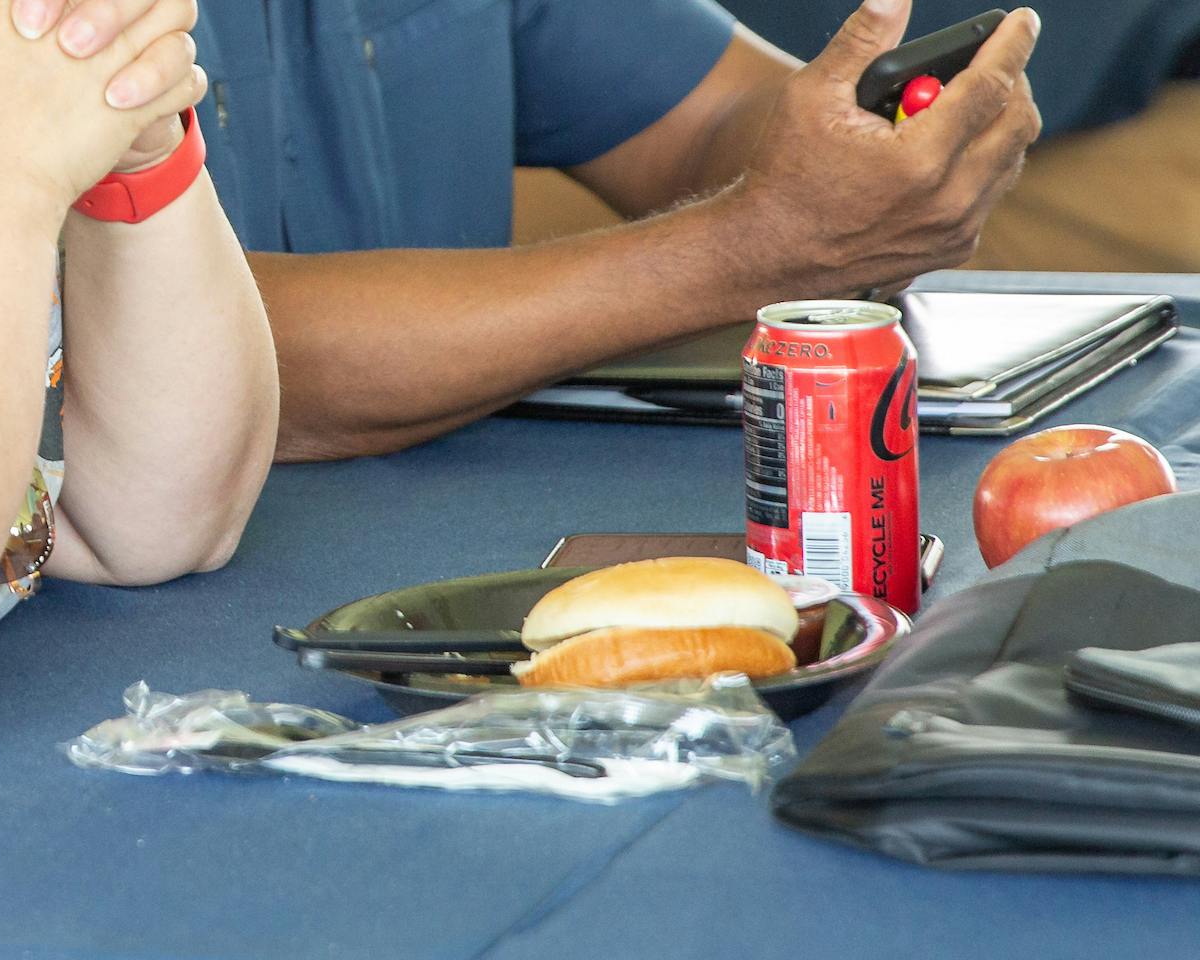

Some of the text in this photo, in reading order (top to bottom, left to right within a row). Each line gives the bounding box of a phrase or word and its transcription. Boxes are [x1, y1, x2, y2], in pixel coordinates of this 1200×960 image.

[775, 340, 829, 359] ZERO
[870, 476, 888, 600] ECYCLE ME
